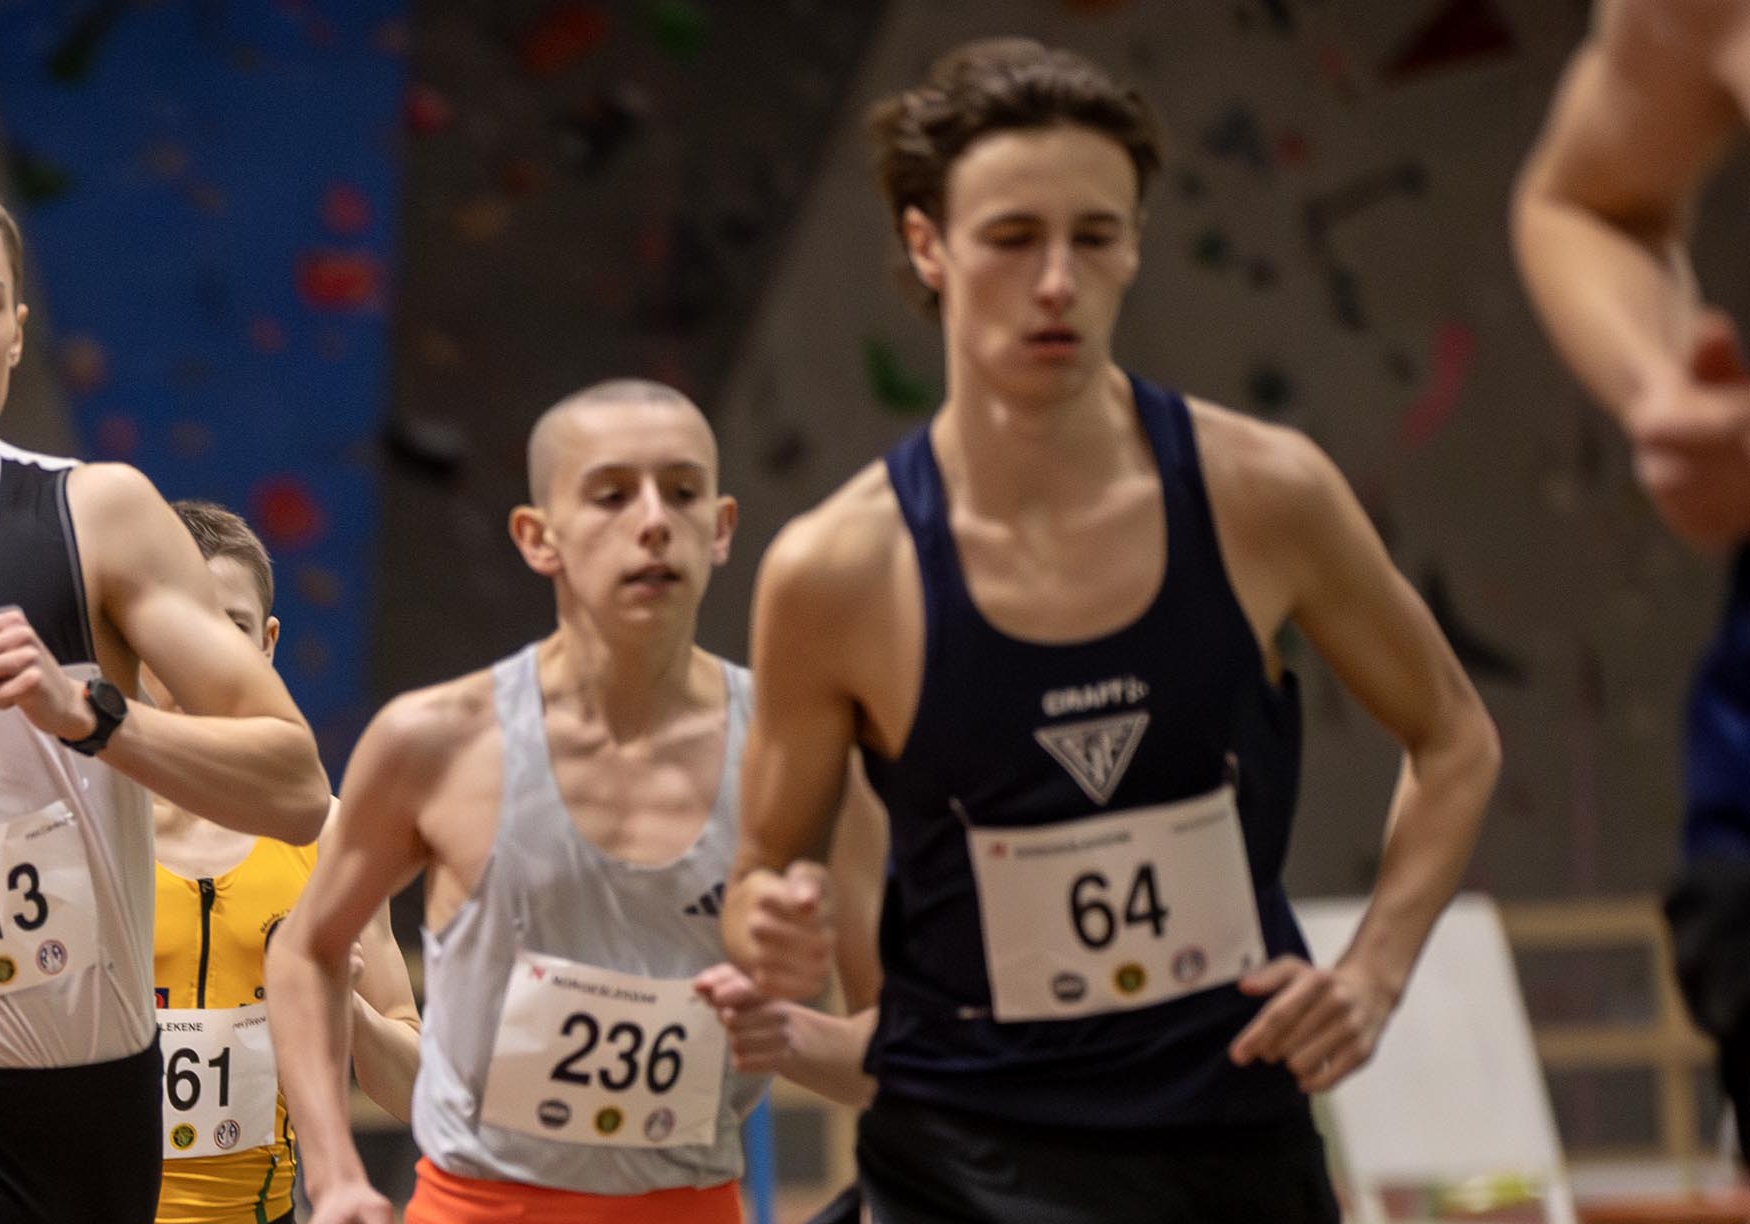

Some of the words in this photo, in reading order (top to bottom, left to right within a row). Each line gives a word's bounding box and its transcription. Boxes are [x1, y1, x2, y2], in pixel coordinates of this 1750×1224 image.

[1069, 861, 1169, 950] 64
[165, 1046, 231, 1112] 61
[550, 1011, 688, 1095] 236
